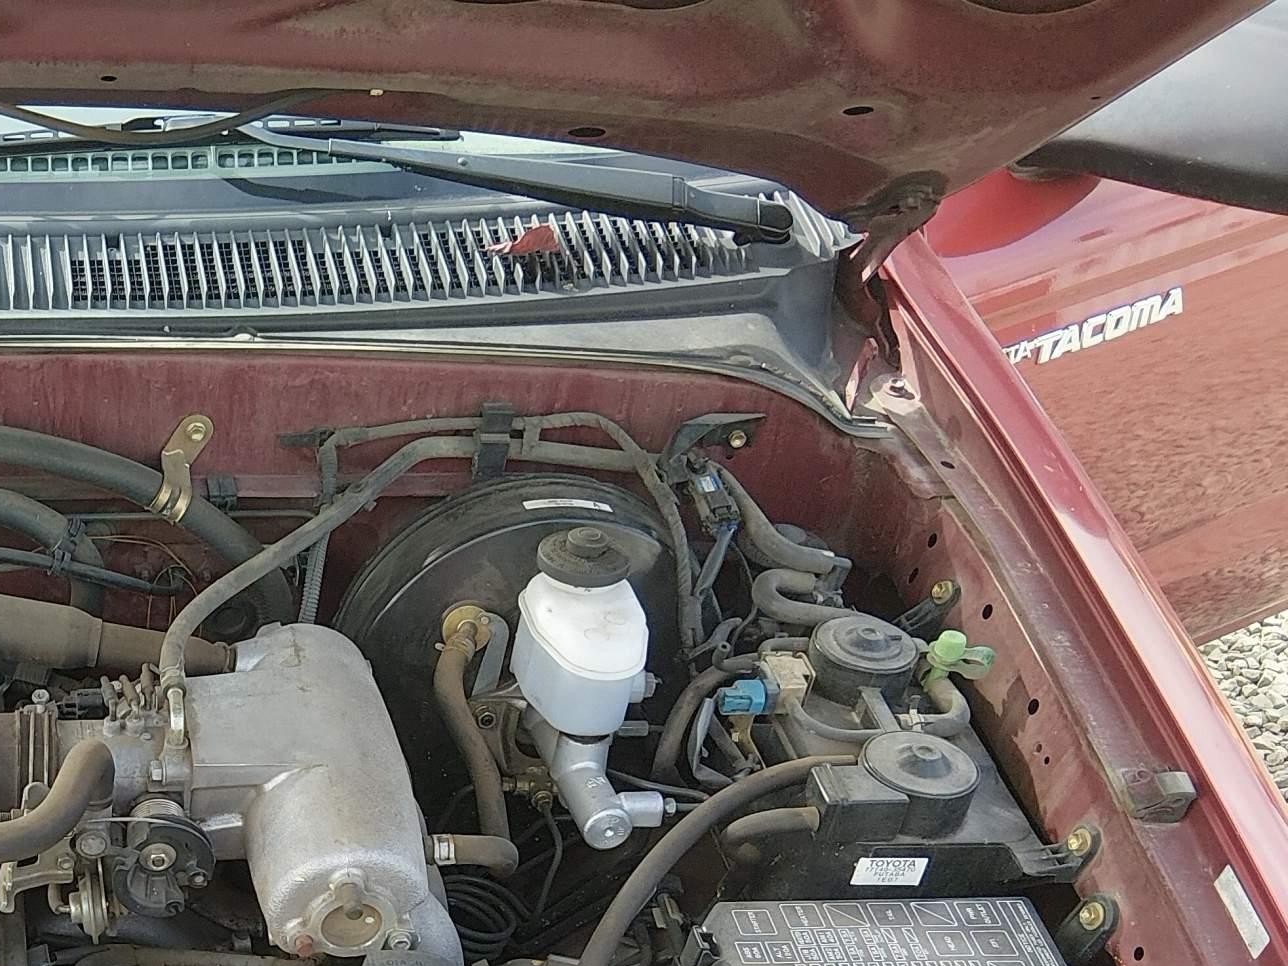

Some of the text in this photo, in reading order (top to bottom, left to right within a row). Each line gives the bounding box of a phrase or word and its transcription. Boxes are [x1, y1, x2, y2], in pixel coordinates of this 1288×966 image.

[1036, 287, 1184, 364] TACOMA
[869, 859, 916, 868] TOYOTA
[773, 948, 784, 958] ALT
